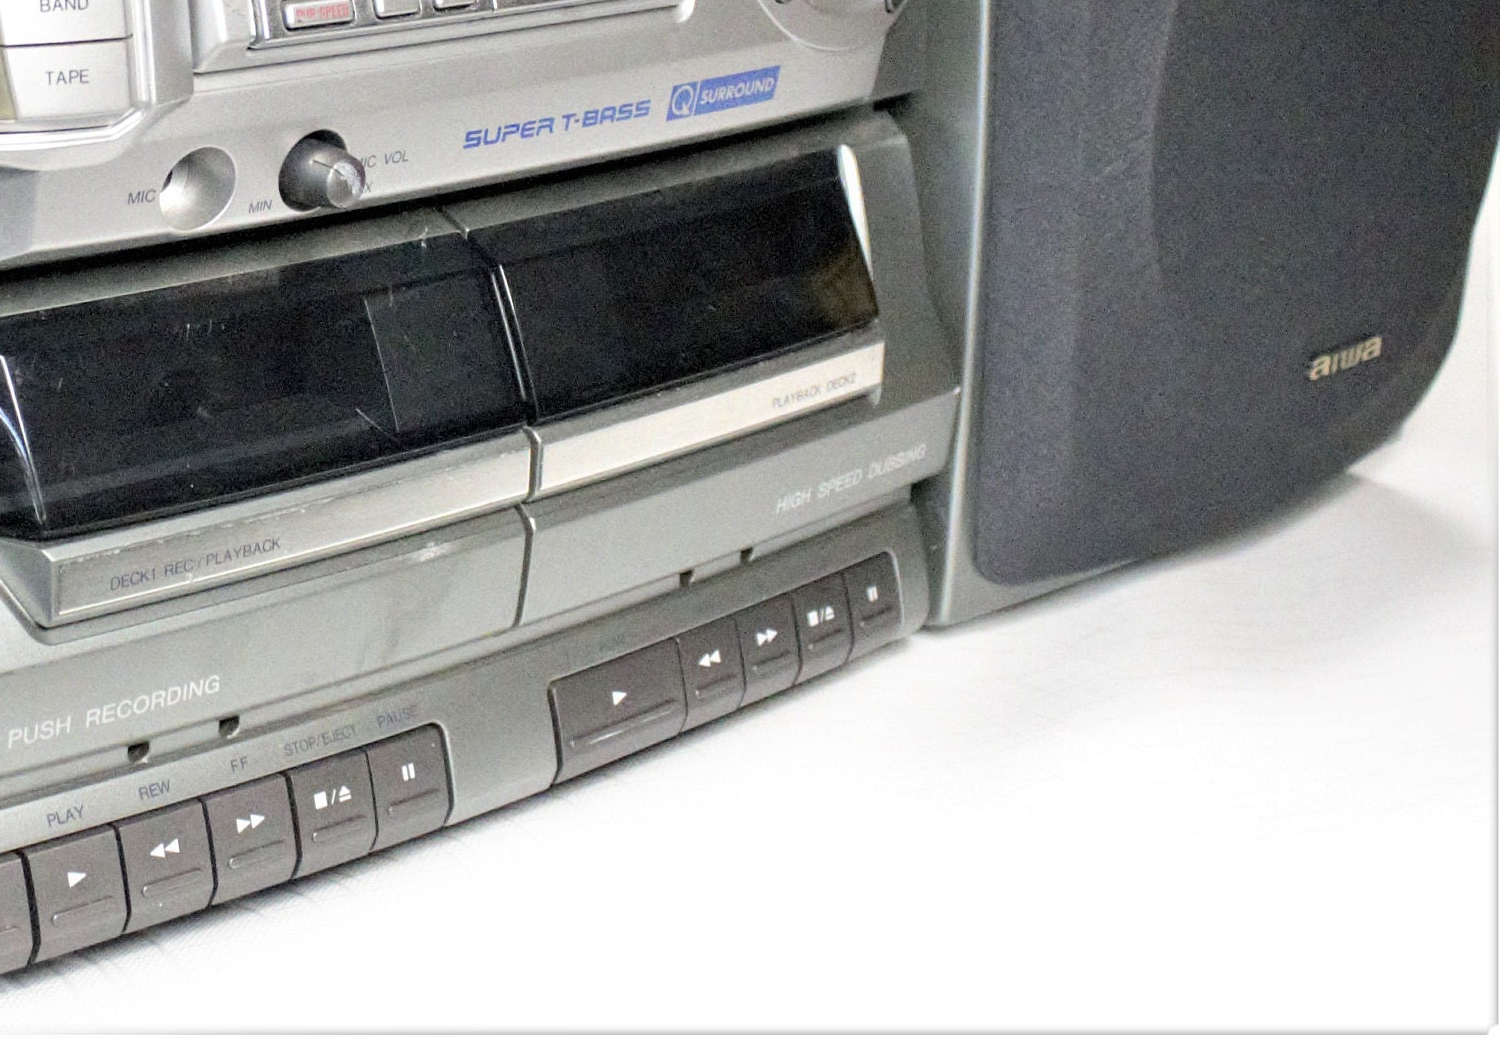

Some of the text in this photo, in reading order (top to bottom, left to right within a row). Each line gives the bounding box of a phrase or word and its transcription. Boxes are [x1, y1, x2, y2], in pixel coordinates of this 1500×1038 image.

[44, 69, 90, 86] TAPE
[671, 77, 775, 116] Q SURROUND
[462, 99, 651, 150] SUPER T-BASS
[385, 150, 408, 165] VOL
[127, 188, 157, 205] MIC
[248, 199, 273, 213] MIN
[1309, 335, 1383, 381] aiwa
[775, 487, 813, 514] HIGH
[817, 468, 863, 498] SPEED
[7, 715, 72, 750] PUSH
[85, 675, 221, 727] RECORDING
[377, 705, 417, 729] PAUSE
[284, 725, 358, 757] STOP/EJECT
[230, 756, 249, 773] FF
[138, 779, 172, 800] REW
[46, 804, 85, 828] PLAY
